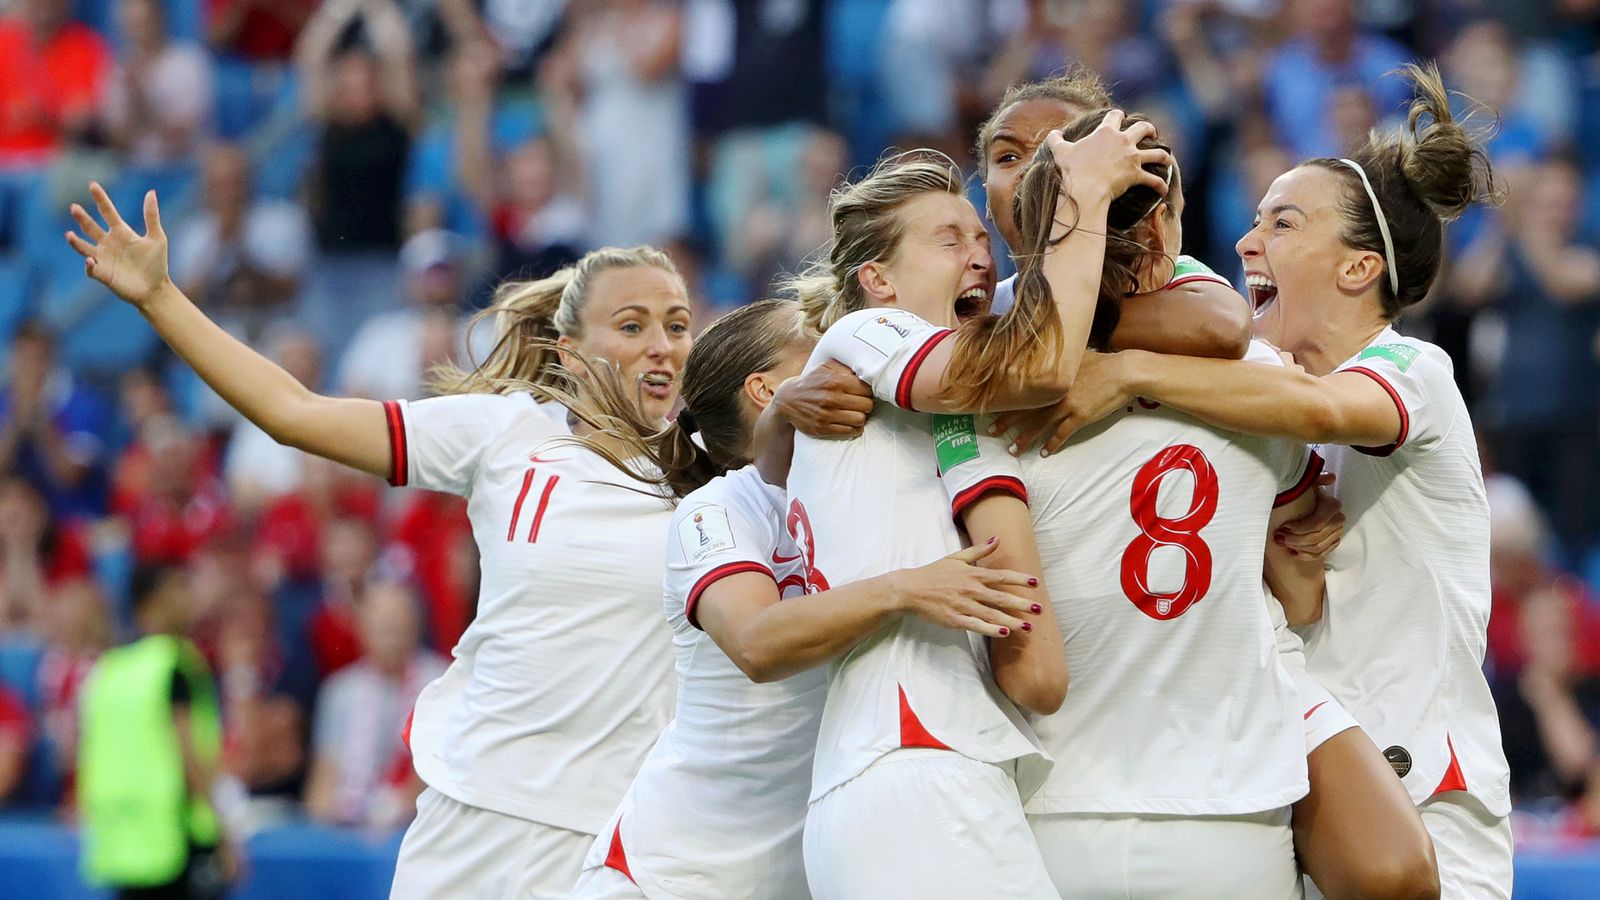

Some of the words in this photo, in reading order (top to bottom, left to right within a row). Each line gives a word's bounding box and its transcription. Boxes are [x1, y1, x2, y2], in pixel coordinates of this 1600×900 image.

[951, 434, 972, 448] FIFA
[507, 467, 560, 544] 11
[1120, 444, 1219, 621] 8
